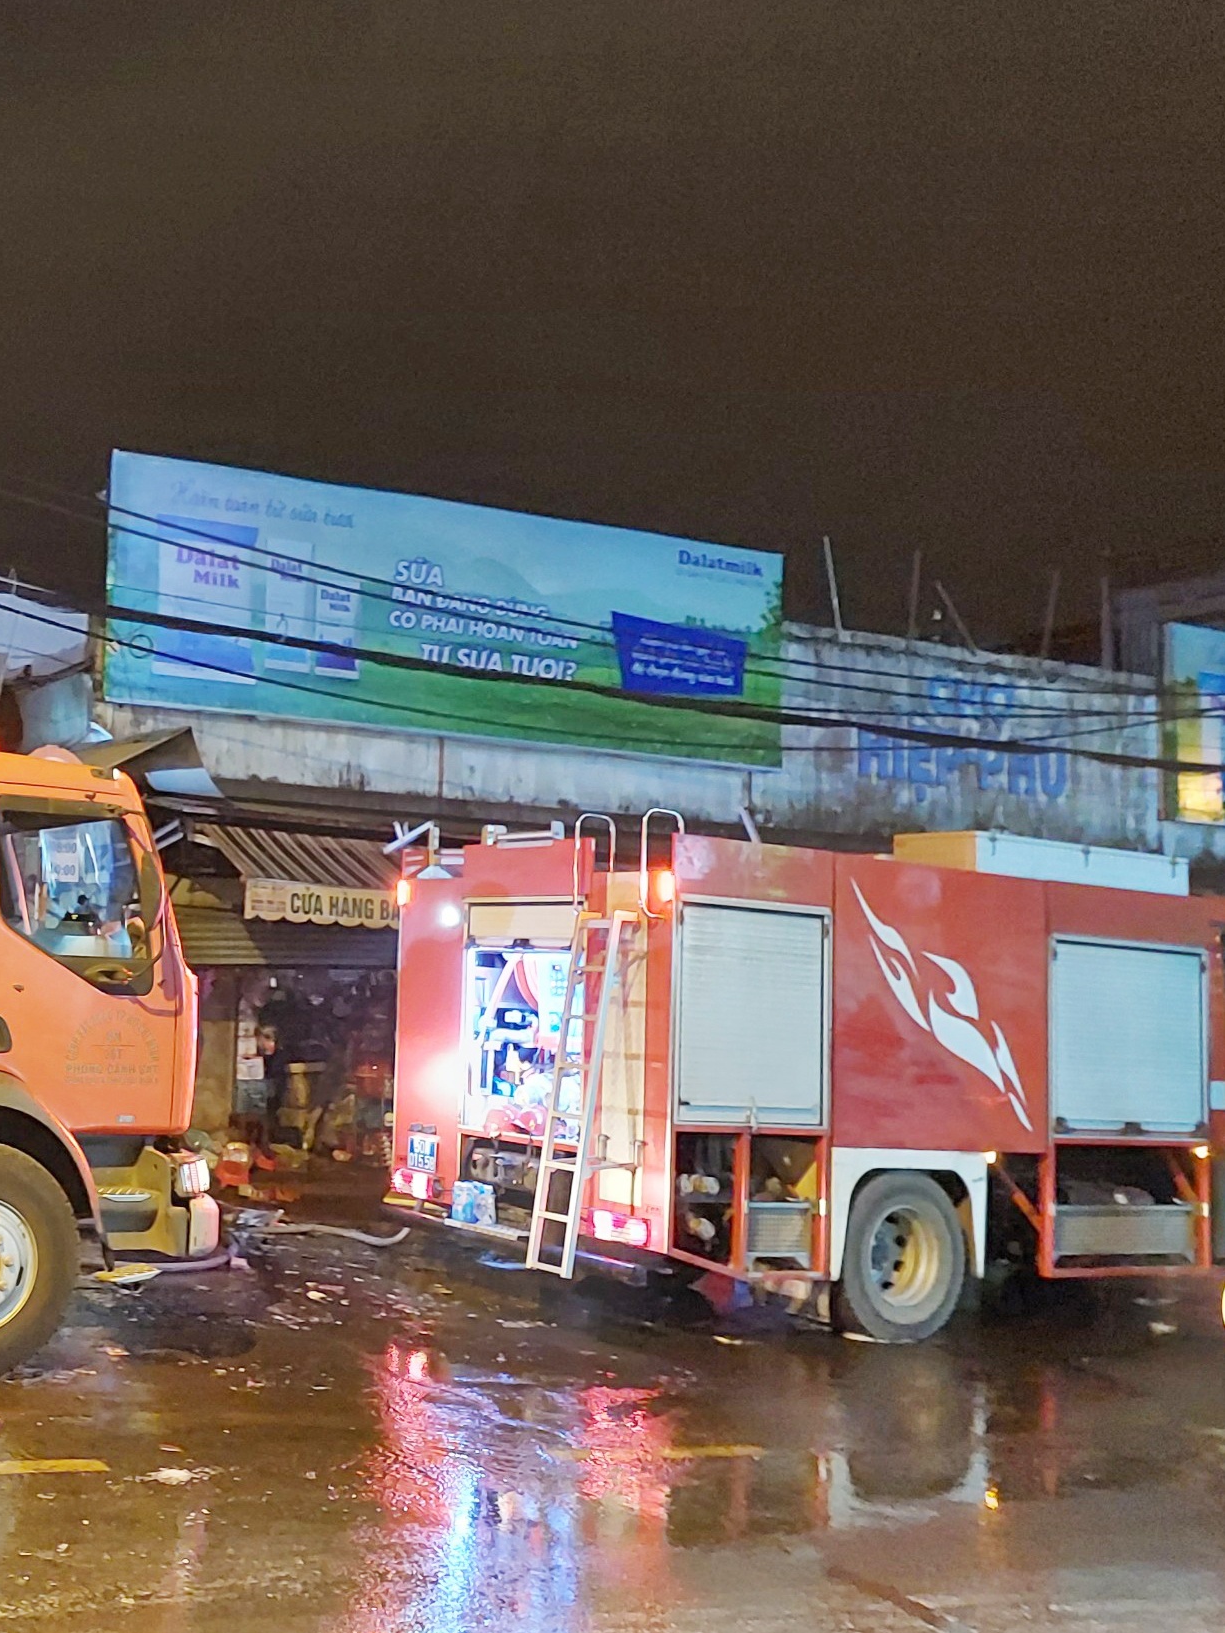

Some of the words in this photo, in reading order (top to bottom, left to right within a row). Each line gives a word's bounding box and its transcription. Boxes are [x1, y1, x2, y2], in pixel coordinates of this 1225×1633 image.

[193, 569, 240, 590] Milk
[290, 887, 323, 916] CỬA
[329, 891, 375, 919] HÀNG
